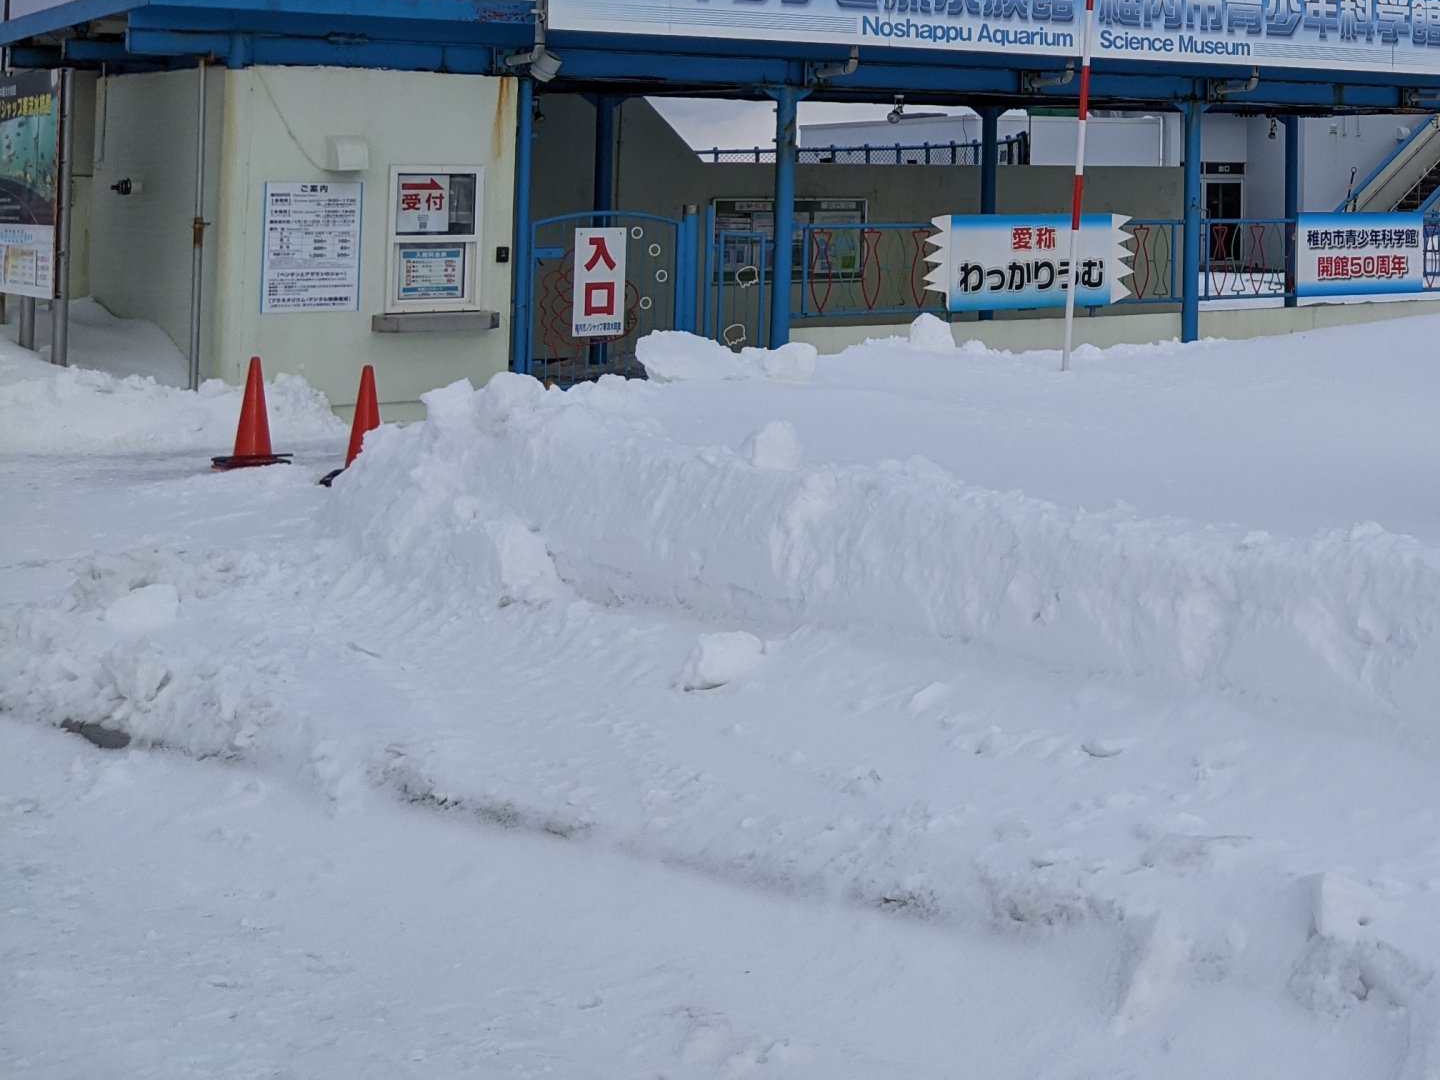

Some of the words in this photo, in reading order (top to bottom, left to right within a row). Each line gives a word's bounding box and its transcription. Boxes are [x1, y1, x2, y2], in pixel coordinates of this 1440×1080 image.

[861, 14, 972, 45] Noshappu
[977, 23, 1073, 47] Aquarium
[1100, 30, 1174, 52] Science
[1179, 35, 1251, 57] Museum
[300, 185, 329, 193] ご案内
[401, 192, 445, 211] 受付
[1012, 227, 1056, 250] 愛称
[1306, 229, 1418, 247] 稚内市青少年科学館
[584, 237, 617, 316] 入口
[960, 260, 1104, 293] わっかりうむ
[1317, 255, 1407, 277] 開館50周年
